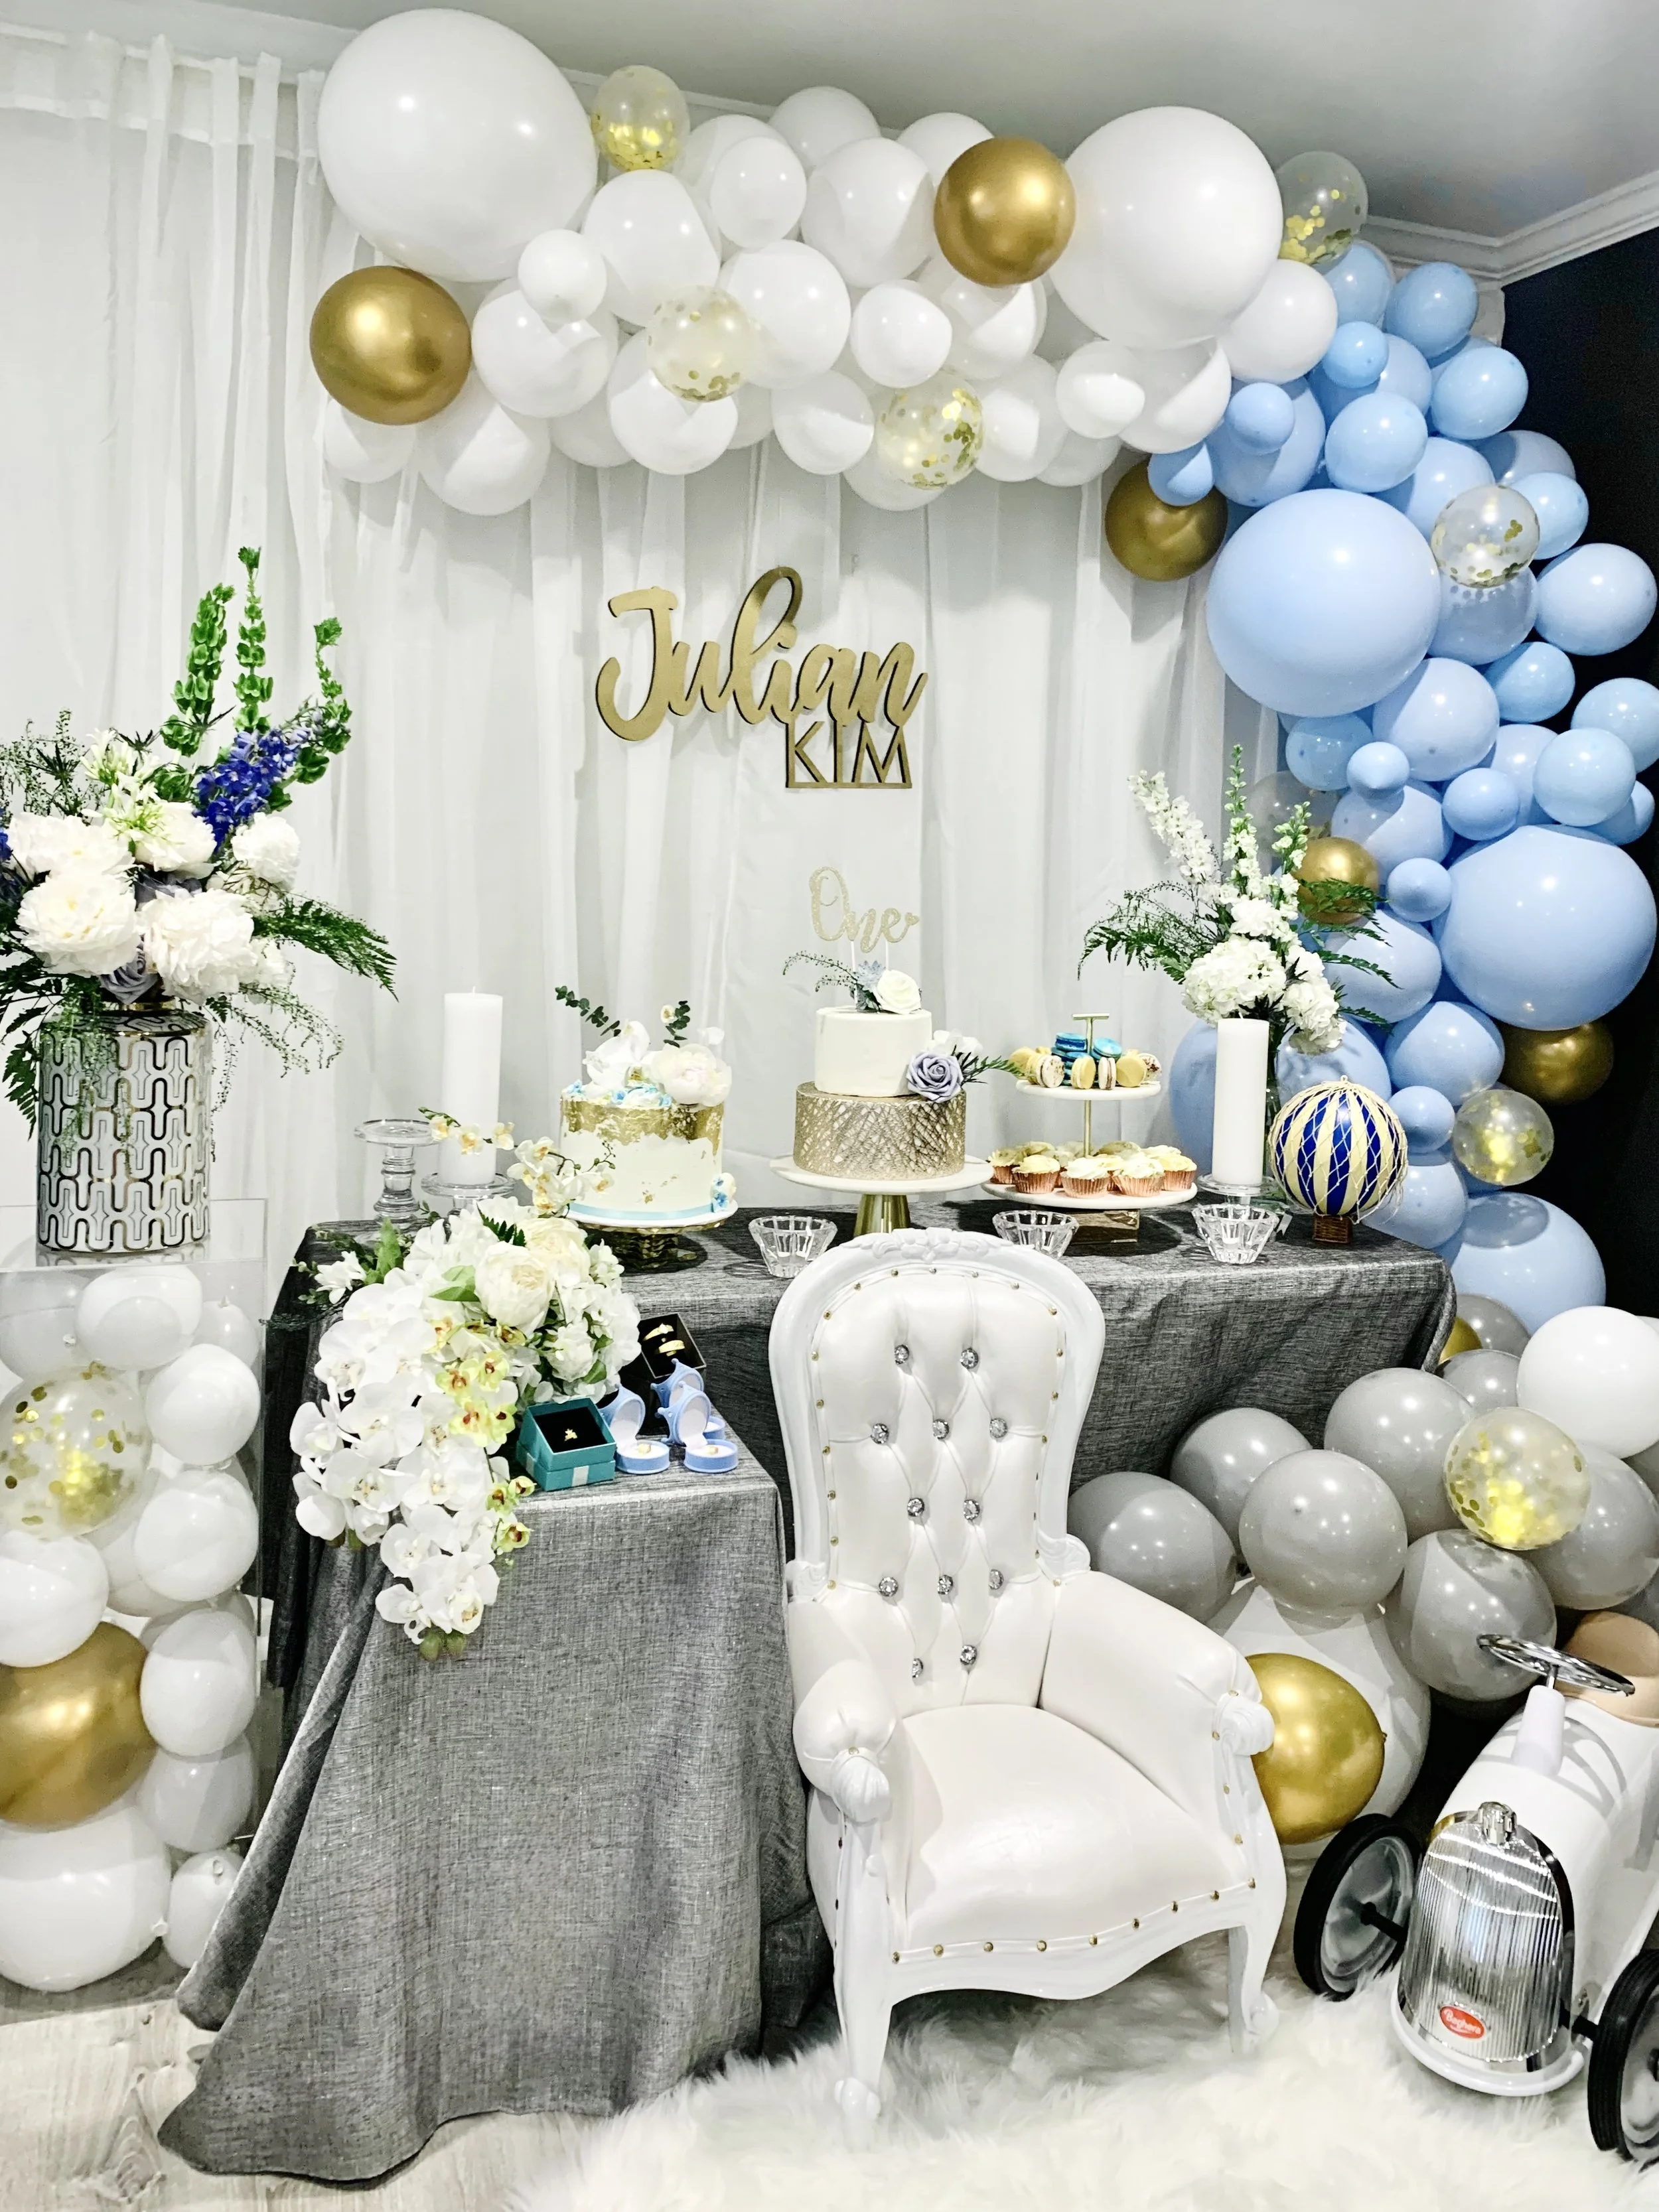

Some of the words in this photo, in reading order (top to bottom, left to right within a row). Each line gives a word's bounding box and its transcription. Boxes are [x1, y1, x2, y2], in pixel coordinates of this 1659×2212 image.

[596, 567, 928, 741] Julian
[786, 721, 912, 788] KIM
[808, 866, 920, 953] One
